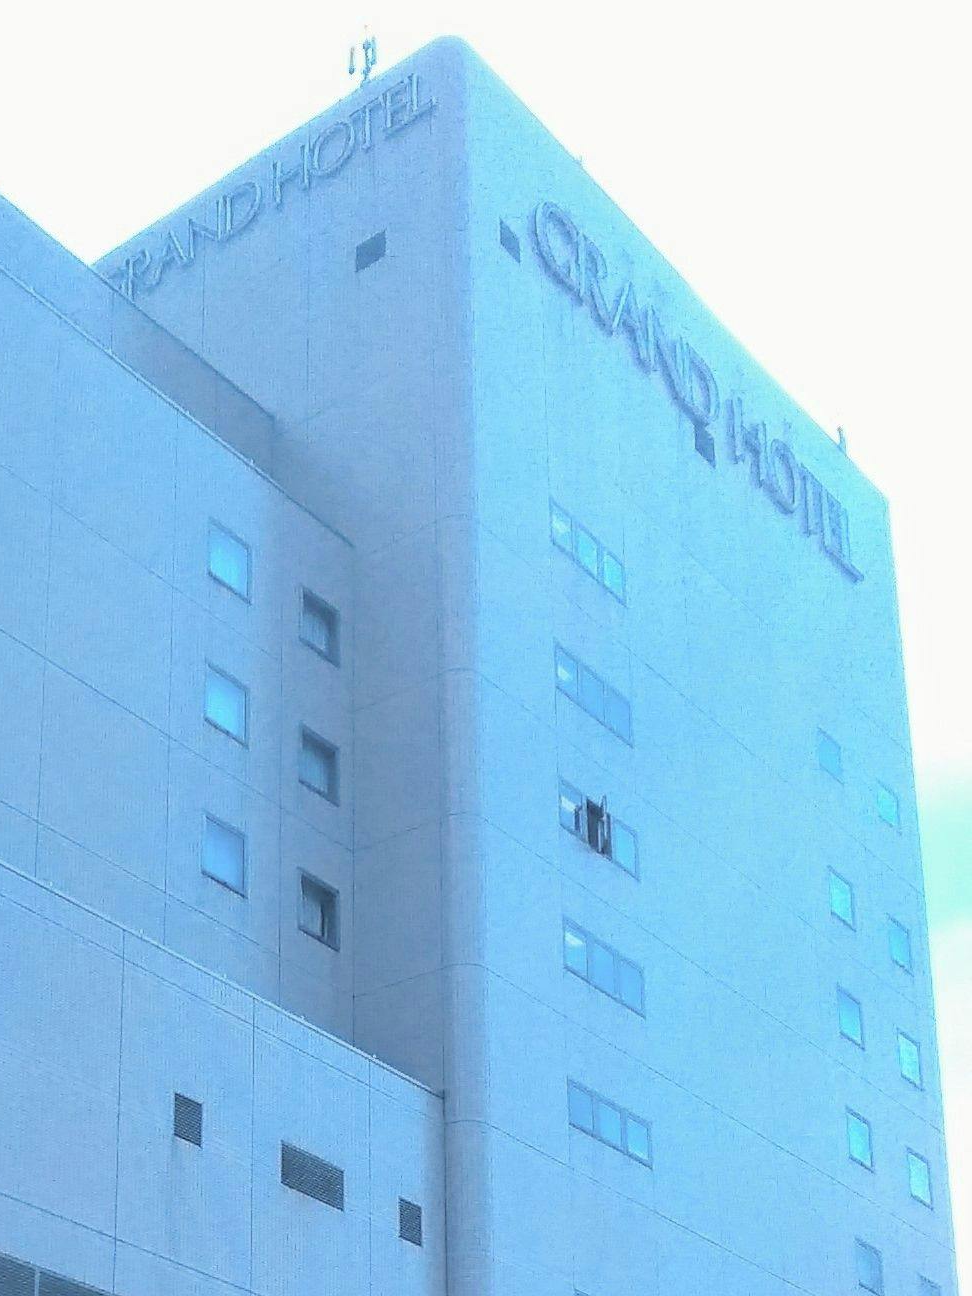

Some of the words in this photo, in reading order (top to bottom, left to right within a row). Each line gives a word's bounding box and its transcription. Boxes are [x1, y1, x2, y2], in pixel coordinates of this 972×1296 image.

[106, 181, 264, 299] RAND
[271, 72, 438, 209] HOTEL
[529, 201, 721, 427] GRAND
[725, 394, 865, 584] HOTEL
